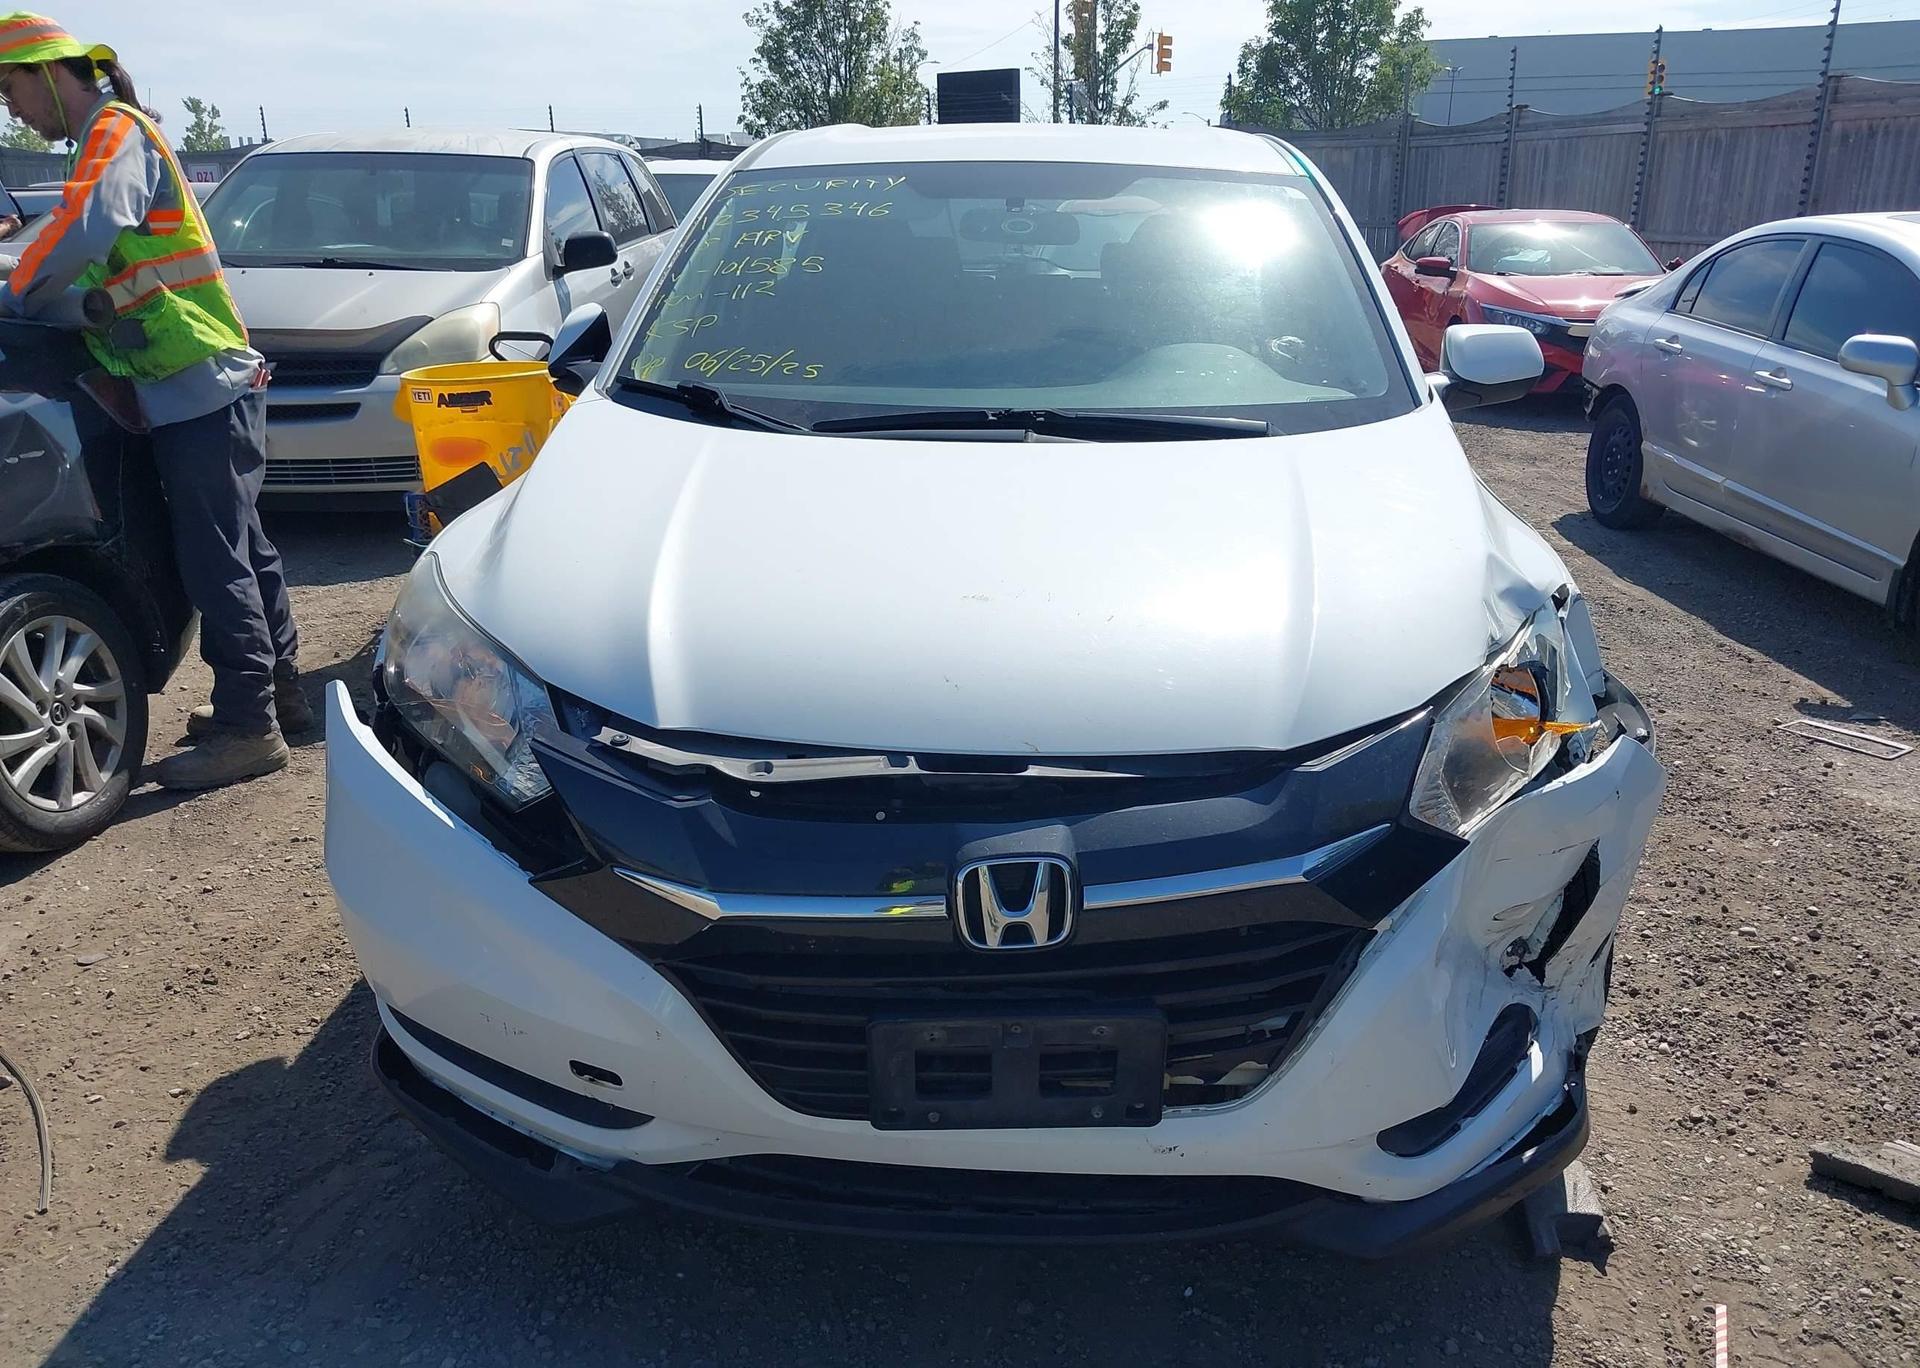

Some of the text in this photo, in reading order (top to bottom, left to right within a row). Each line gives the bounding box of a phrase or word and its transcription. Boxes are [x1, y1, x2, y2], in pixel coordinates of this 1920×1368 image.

[718, 176, 906, 201] SECURITY
[684, 346, 824, 378] 06/25/25
[413, 390, 431, 401] YETI
